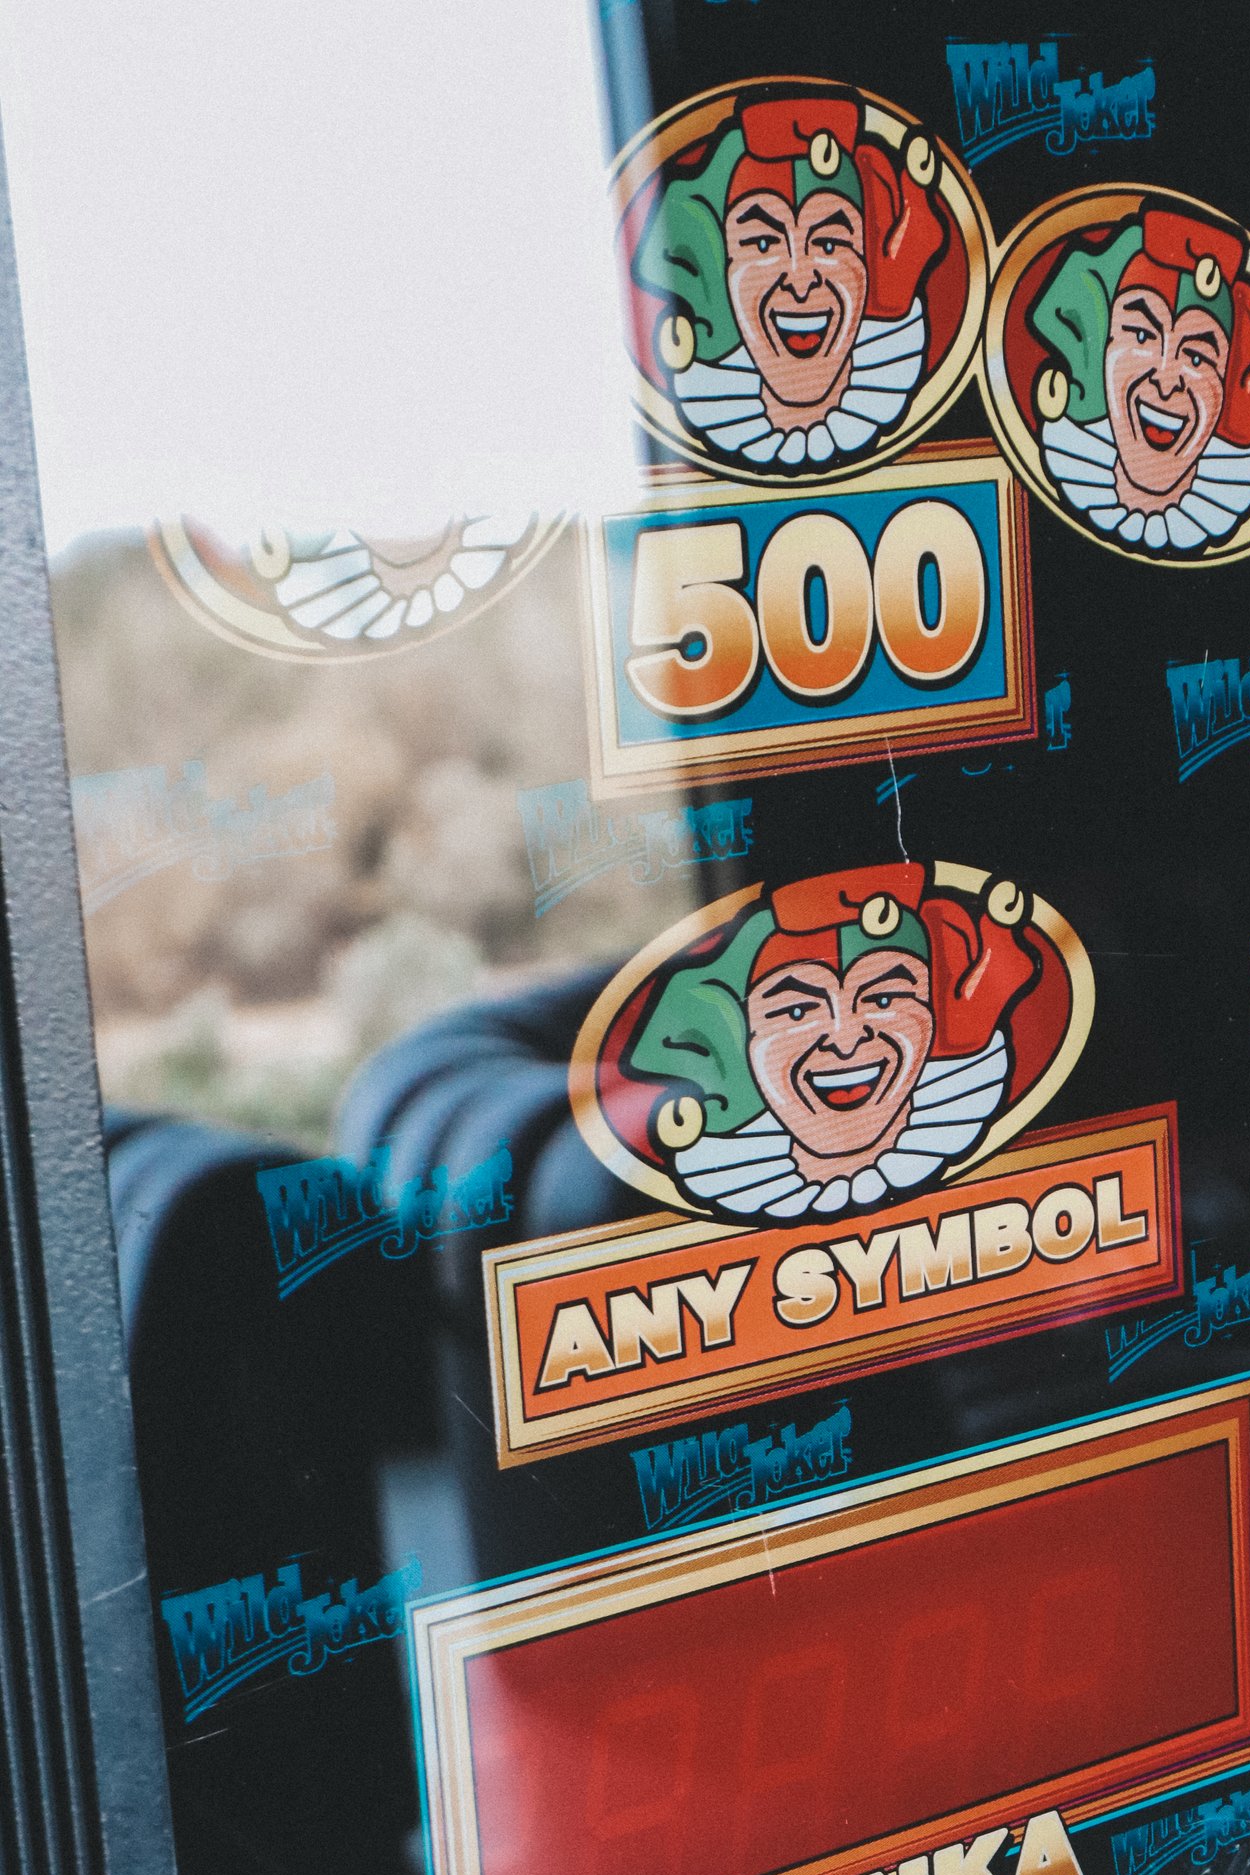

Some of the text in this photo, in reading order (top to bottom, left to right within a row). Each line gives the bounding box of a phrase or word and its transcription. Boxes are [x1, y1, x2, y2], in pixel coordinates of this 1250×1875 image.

[945, 42, 1157, 156] Wild Joker
[626, 499, 988, 721] 500
[256, 1145, 514, 1273] Wild Joker
[532, 1256, 760, 1395] ANY
[773, 1173, 1151, 1326] SYMBOL
[736, 1405, 853, 1511] Joker
[161, 1562, 303, 1699] Wild
